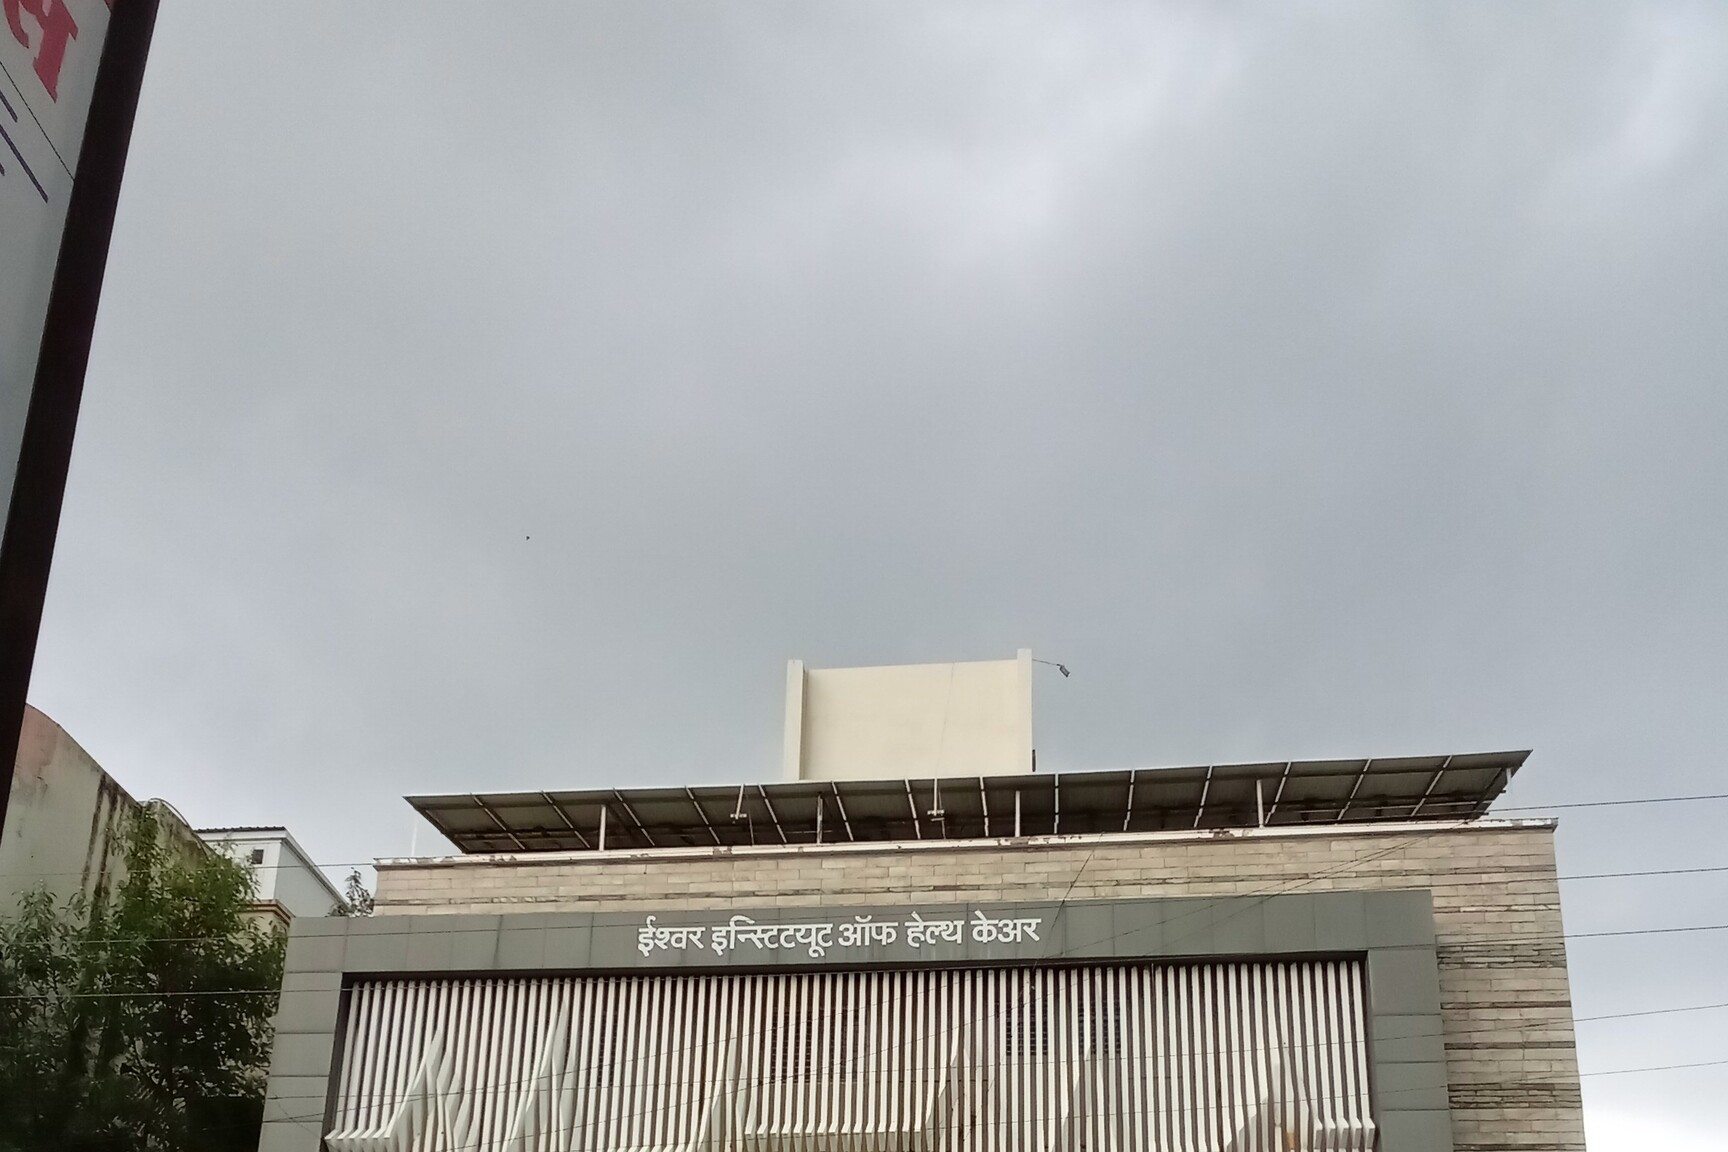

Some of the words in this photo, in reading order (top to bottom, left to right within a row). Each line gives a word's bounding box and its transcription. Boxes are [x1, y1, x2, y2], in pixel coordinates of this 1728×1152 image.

[638, 915, 705, 957] ईश्वर
[838, 915, 898, 947] ऑफ
[905, 911, 965, 948] हेल्थ
[971, 910, 1042, 946] केअर
